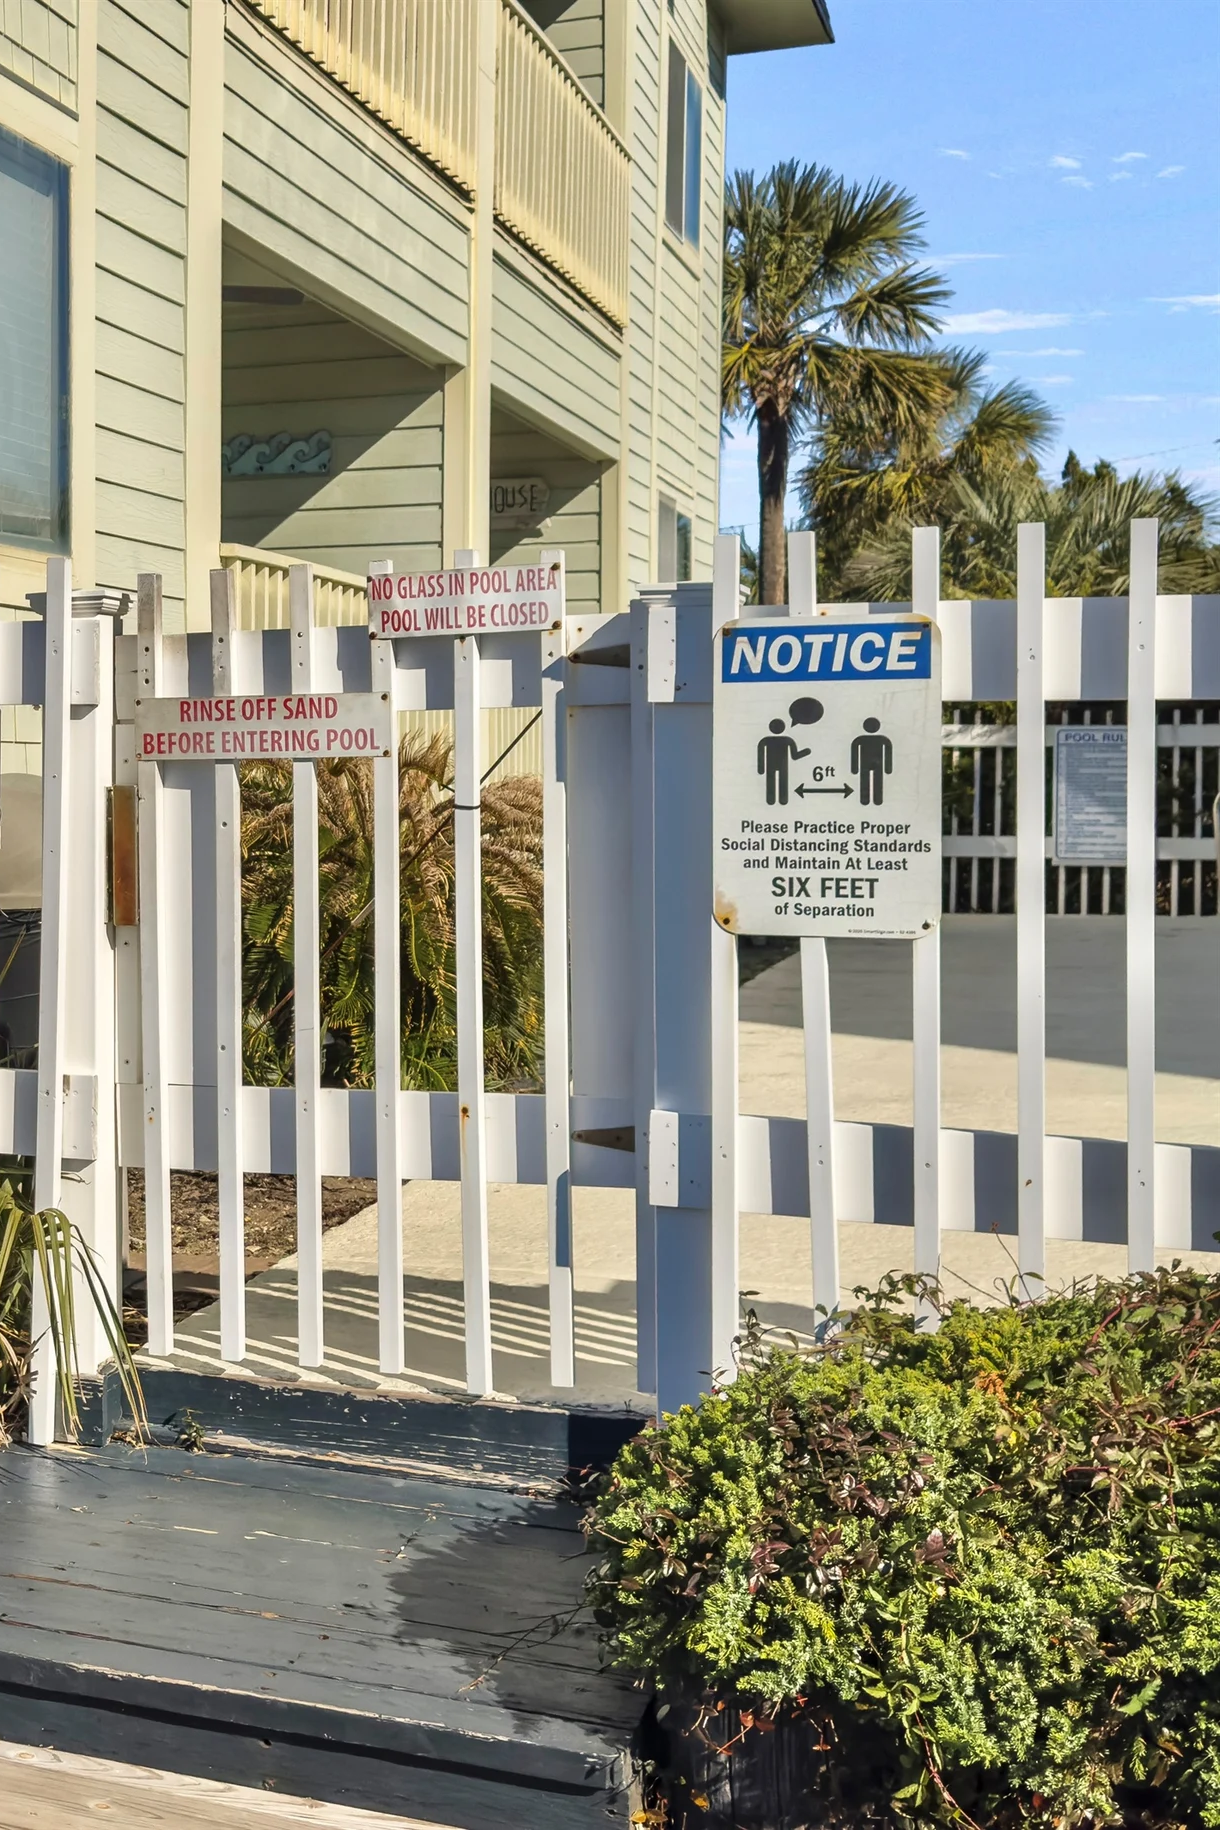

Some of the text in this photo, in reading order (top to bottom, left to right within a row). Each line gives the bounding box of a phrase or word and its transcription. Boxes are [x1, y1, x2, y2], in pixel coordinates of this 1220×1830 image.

[490, 484, 538, 513] OUSE
[371, 568, 557, 600] NO GLASS IN POOL AREA
[381, 601, 550, 633] POOL WILL BE CLOSED
[730, 631, 922, 675] NOTICE
[180, 696, 338, 722] RINSE OFF SAND
[142, 728, 380, 755] BEFORE ENTERING POOL
[1064, 732, 1126, 742] POOL RUL
[741, 820, 911, 837] Please Practice Proper
[721, 838, 932, 854] Social Distancing Standards
[743, 856, 908, 871] and Maintain At Least
[771, 877, 879, 899] SIX FEET
[774, 902, 875, 918] of Separation
